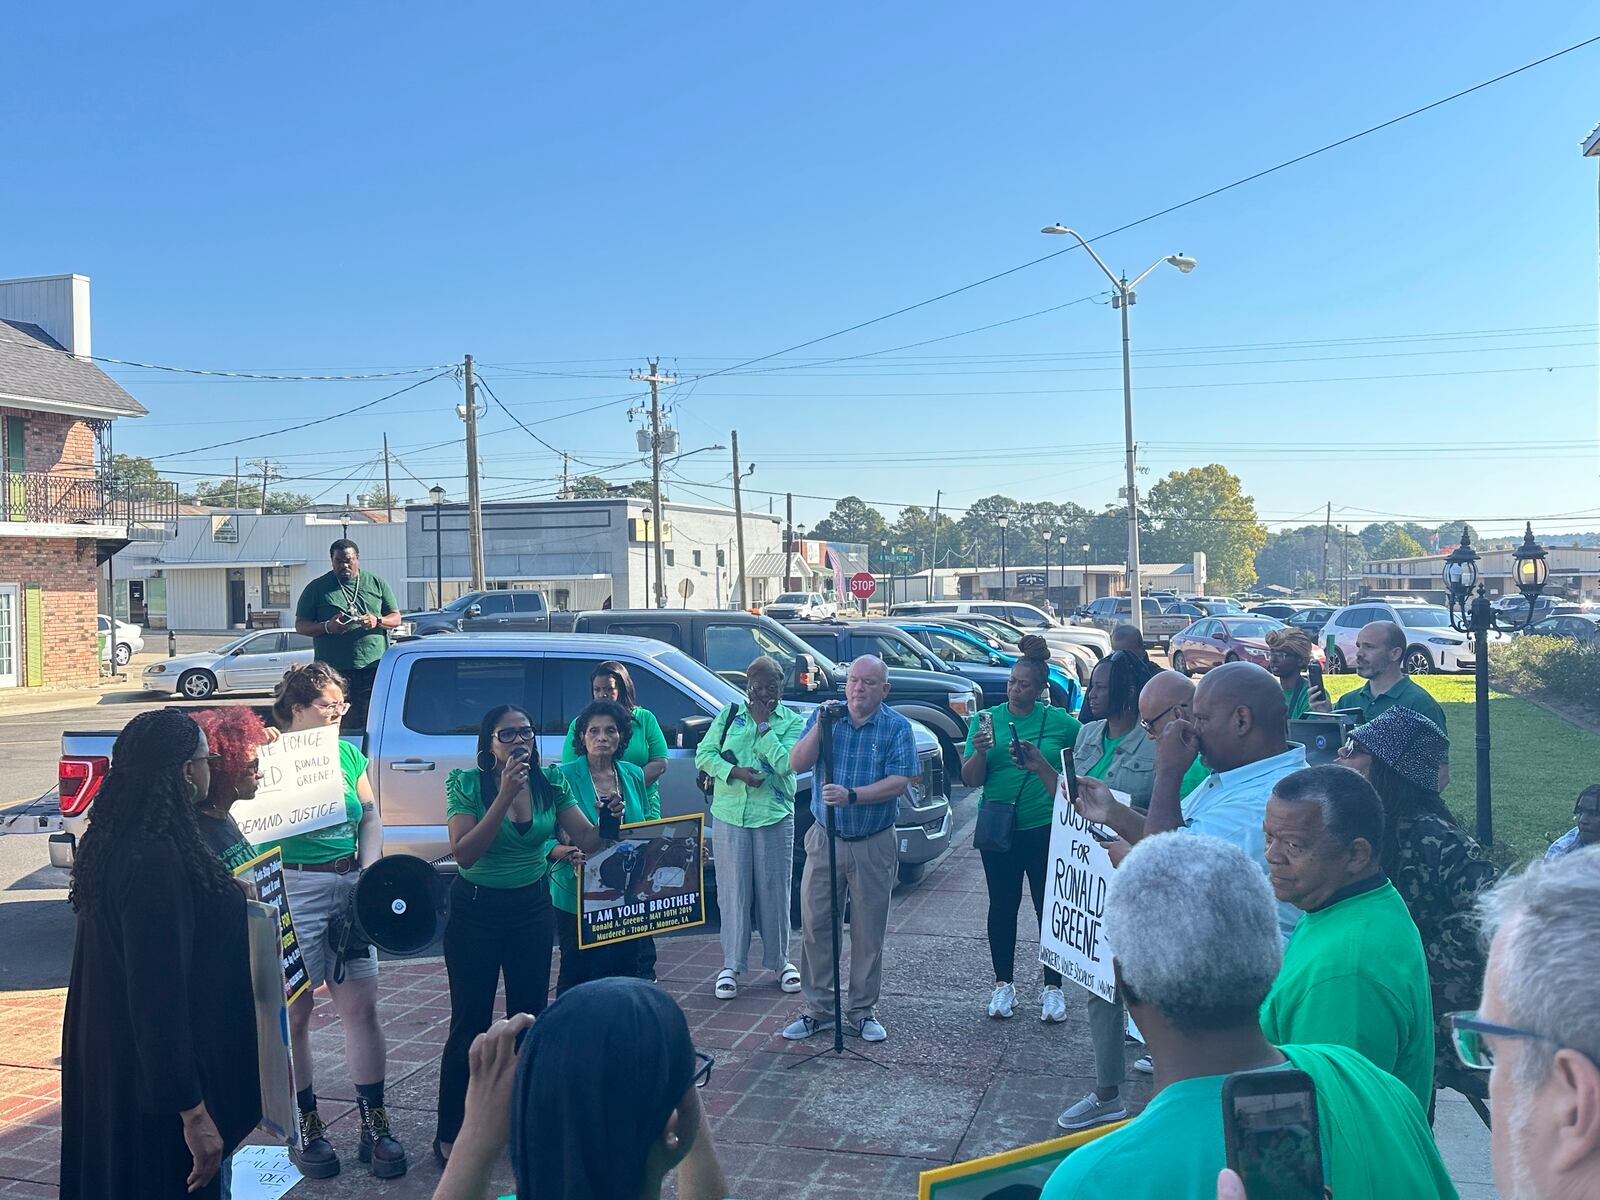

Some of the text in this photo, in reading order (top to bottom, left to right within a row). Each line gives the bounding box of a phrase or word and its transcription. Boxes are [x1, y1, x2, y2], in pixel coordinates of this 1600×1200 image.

[852, 580, 875, 591] STOP
[283, 731, 324, 752] POLICE
[294, 756, 330, 772] RONALD
[297, 770, 334, 787] GREENE!
[238, 813, 283, 834] DEMAND
[289, 802, 338, 824] JUSTICE
[1071, 839, 1090, 865] FOR
[1054, 858, 1107, 919] RONALD
[583, 892, 699, 924] "I AM YOUR BROTHER"
[592, 921, 613, 932] Ronald
[614, 920, 621, 928] A.
[622, 916, 645, 926] Greene
[679, 906, 693, 915] 2019
[596, 927, 626, 941] Murdered
[631, 923, 648, 934] Troop
[656, 917, 680, 929] Monroe,
[1052, 901, 1102, 962] GREENE
[1062, 957, 1074, 975] VOICE
